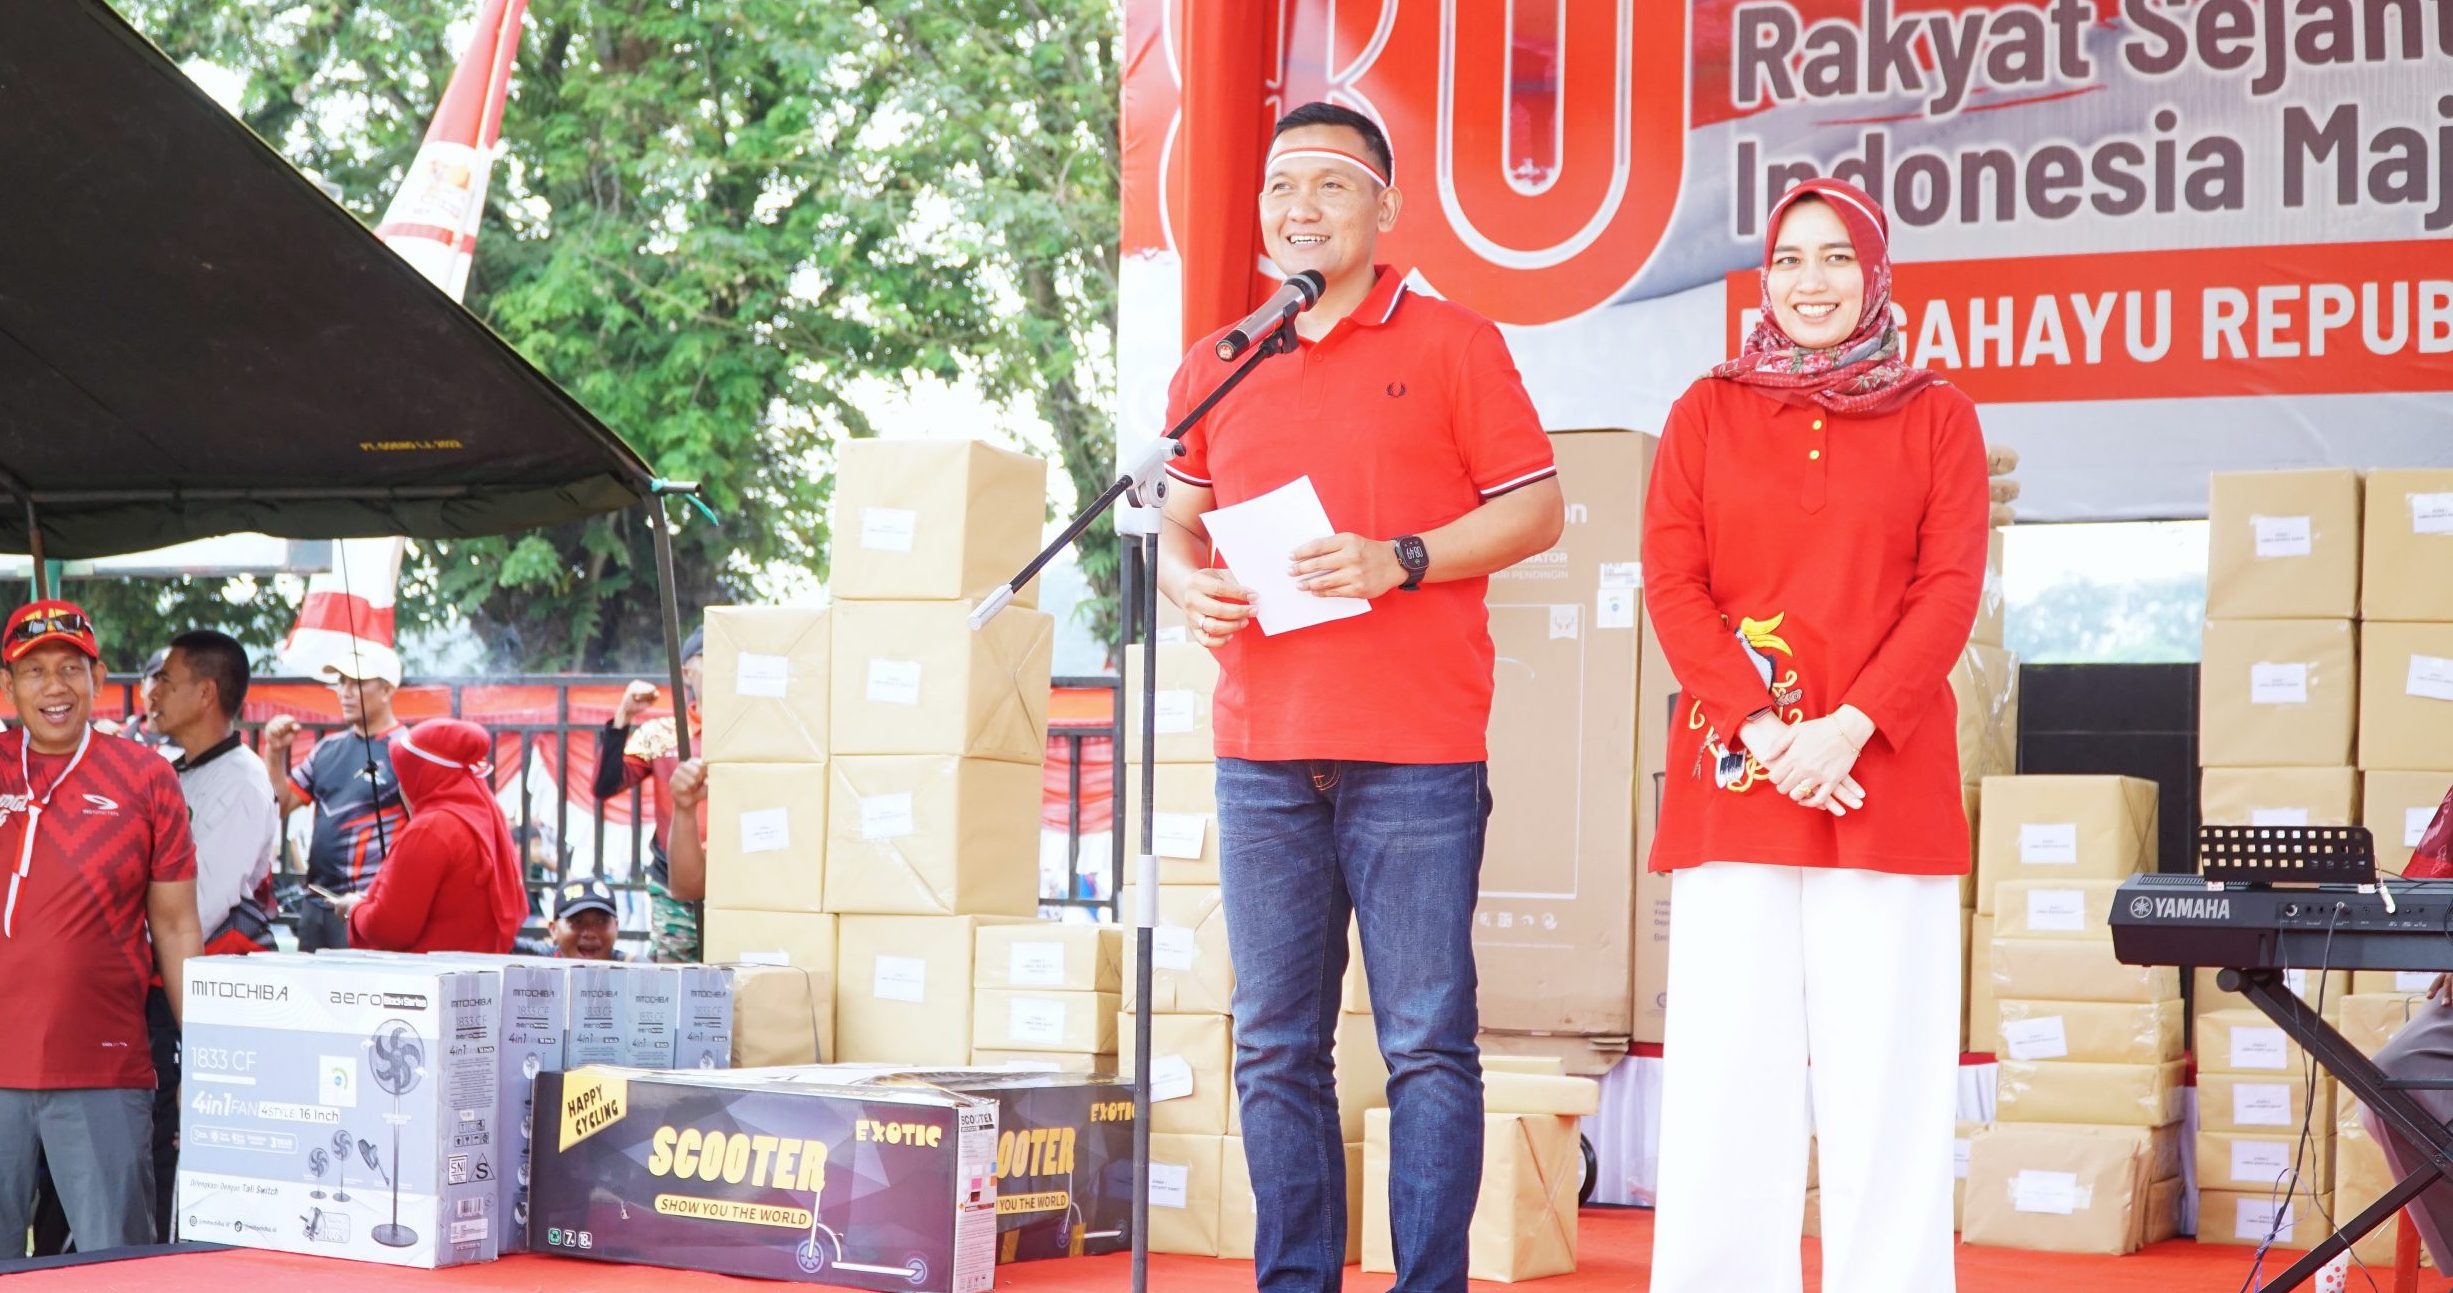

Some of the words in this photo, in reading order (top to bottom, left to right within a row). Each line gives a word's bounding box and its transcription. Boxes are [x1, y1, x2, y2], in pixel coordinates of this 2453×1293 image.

[1738, 0, 2092, 116] Rakyat
[2124, 0, 2453, 96] Sejah
[2155, 897, 2231, 920] YAMAHA
[192, 980, 288, 1002] MITOCHIBA
[330, 991, 382, 1006] aero
[451, 998, 492, 1009] MITOCHIBA
[191, 1046, 229, 1070] 1833
[232, 1048, 257, 1071] CF
[567, 1083, 602, 1118] HAPPY
[299, 1108, 311, 1120] 16
[314, 1109, 340, 1123] Inch
[575, 1099, 619, 1136] CYCLING
[855, 1119, 943, 1148] EXOTIC
[647, 1125, 829, 1193] SCOOTER
[996, 1127, 1076, 1179] OOTER
[660, 1198, 701, 1213] SHOW
[702, 1202, 729, 1217] YOU
[732, 1206, 756, 1220] THE
[759, 1209, 808, 1225] WORLD
[1000, 1198, 1017, 1211] YOU
[1019, 1197, 1036, 1209] THE
[1037, 1195, 1066, 1208] WORLD
